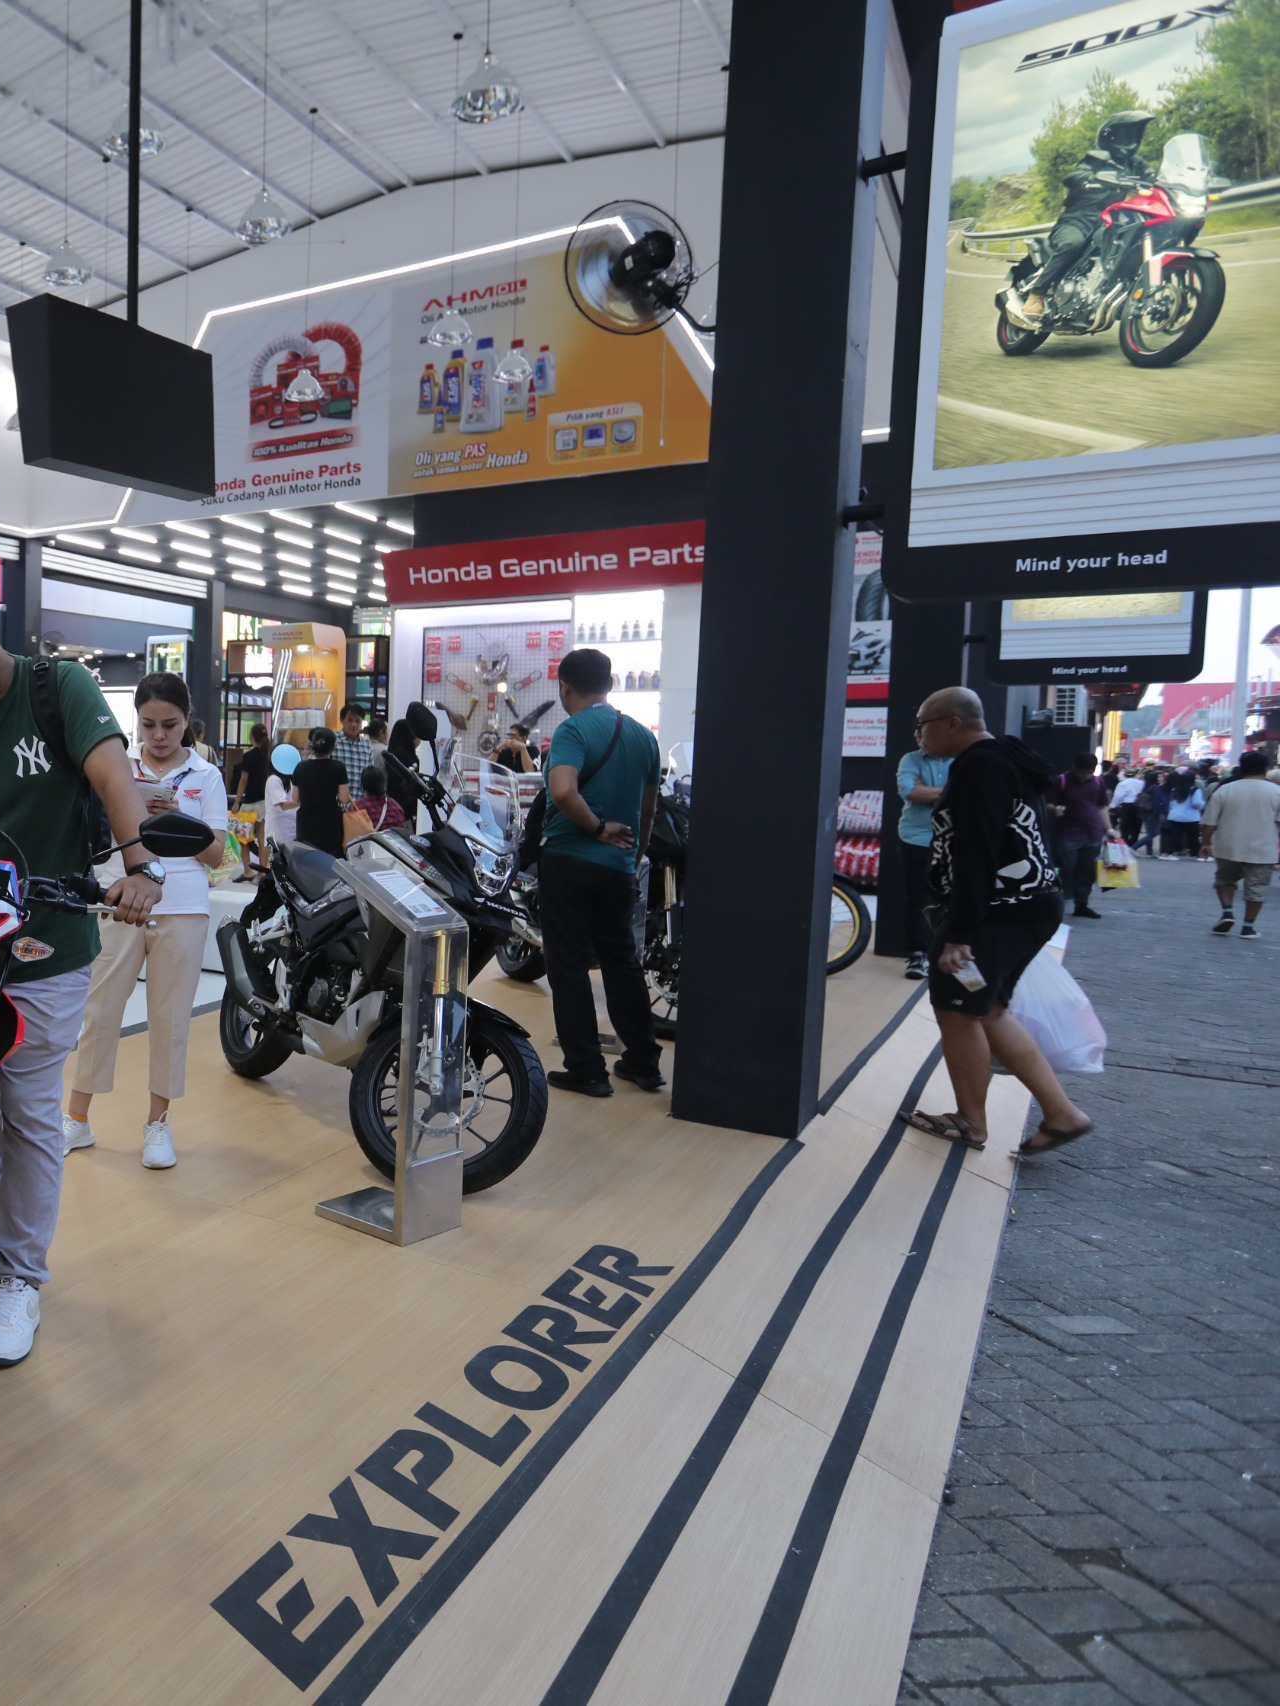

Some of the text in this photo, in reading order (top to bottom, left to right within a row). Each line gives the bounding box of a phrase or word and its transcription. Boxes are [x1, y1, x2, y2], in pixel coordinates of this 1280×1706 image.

[421, 313, 435, 324] Oli
[458, 304, 488, 316] Motor
[491, 296, 526, 311] Honda
[566, 406, 624, 422] Pilih yang ASLI
[252, 433, 353, 458] 100% Kualitas Honda
[415, 443, 487, 467] Oli yang PAS
[215, 462, 362, 492] onda Genuine Parts
[413, 450, 528, 478] untuk semua motor Honda
[200, 476, 361, 506] Suku Cadang Asli Motor Honda
[408, 542, 705, 586] Honda Genuine Parts
[1015, 549, 1168, 573] Mind your head
[1052, 665, 1128, 676] Mind your head
[13, 735, 52, 778] NY
[486, 901, 528, 920] HONDA
[210, 1244, 675, 1693] EXPLORER
